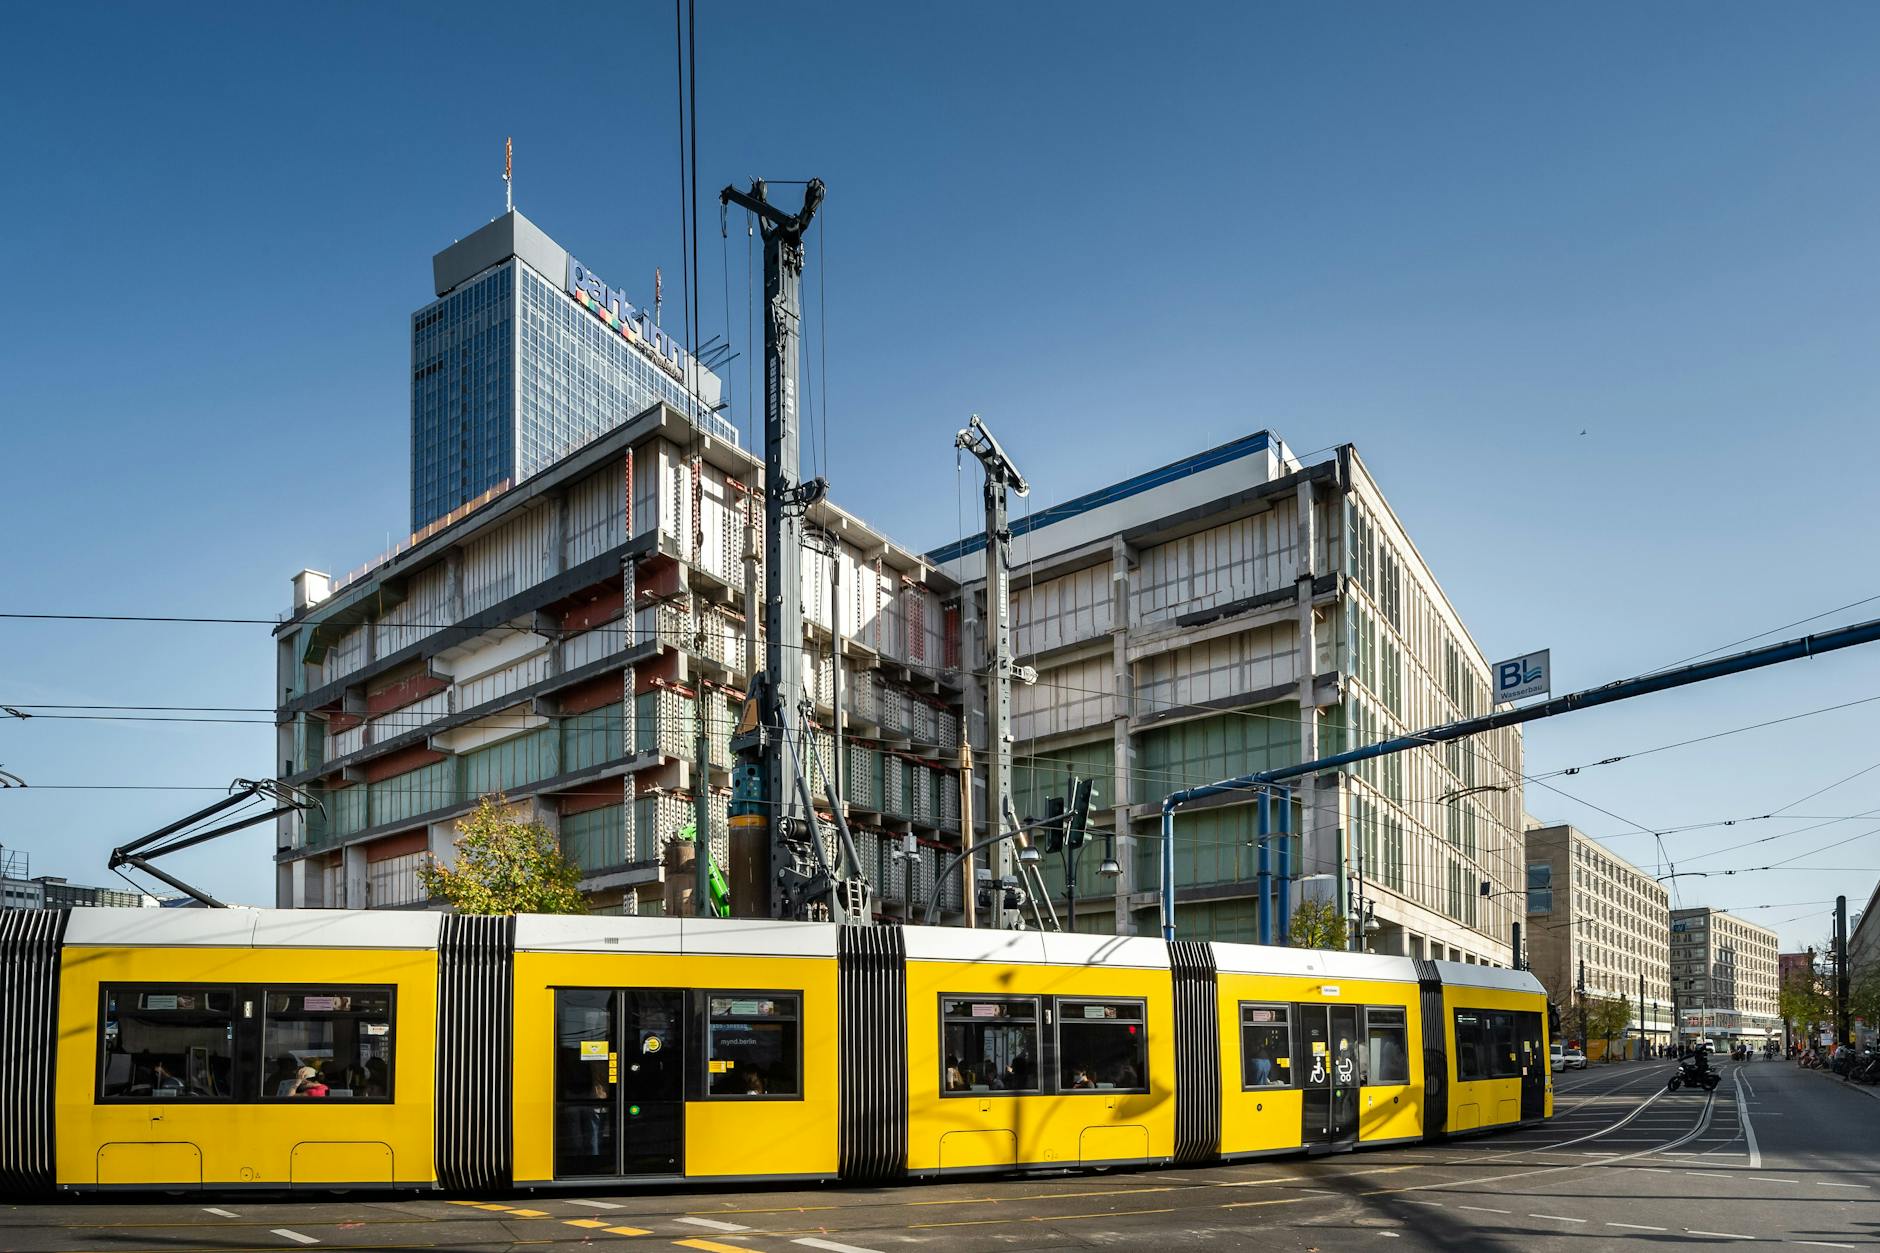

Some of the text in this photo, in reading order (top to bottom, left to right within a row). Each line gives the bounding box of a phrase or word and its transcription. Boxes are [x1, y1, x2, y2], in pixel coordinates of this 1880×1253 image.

[568, 254, 685, 373] park inn
[769, 356, 778, 423] LIEBHERR
[1501, 684, 1543, 699] Wasserbau
